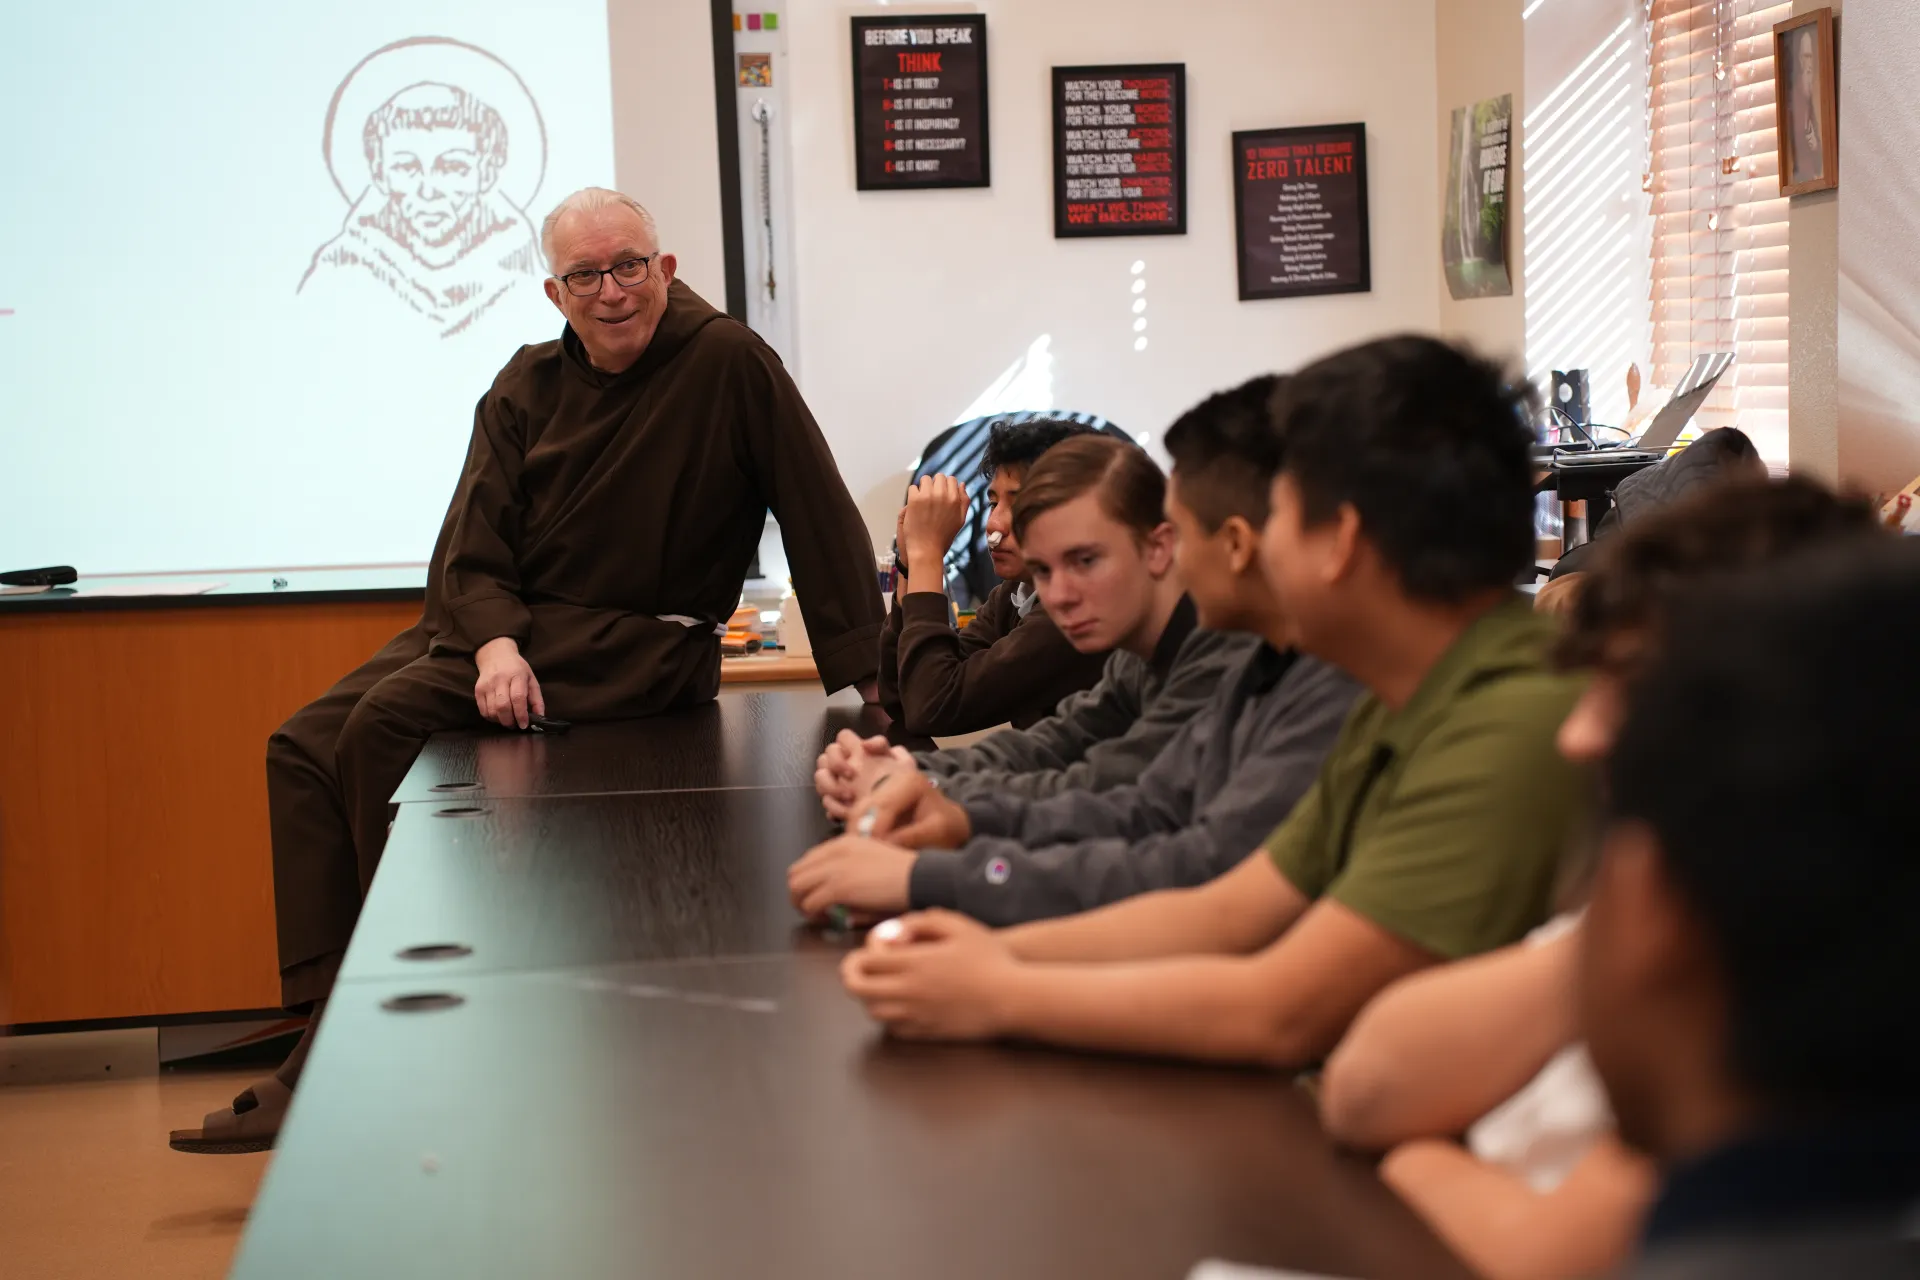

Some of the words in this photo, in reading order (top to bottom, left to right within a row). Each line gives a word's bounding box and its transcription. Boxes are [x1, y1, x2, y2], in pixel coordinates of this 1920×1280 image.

[865, 29, 908, 45] BEFORE
[909, 28, 934, 45] YOU
[935, 27, 972, 44] SPEAK
[897, 52, 943, 72] THINK
[1065, 80, 1098, 90] WATCH
[1098, 80, 1122, 90] YOUR
[1065, 90, 1083, 101] FOR
[1083, 90, 1104, 101] THEY
[1104, 89, 1139, 100] BECOME
[1065, 105, 1101, 115] WATCH
[1103, 104, 1131, 115] YOUR
[1065, 115, 1083, 126] FOR
[1083, 114, 1103, 125] THEY
[1103, 113, 1136, 125] BECOME
[1065, 129, 1101, 139] WATCH
[1101, 128, 1128, 139] YOUR
[1065, 139, 1084, 151] FOR
[1084, 139, 1105, 150] THEY
[1105, 138, 1140, 150] BECOME
[1066, 154, 1103, 164] WATCH
[1103, 153, 1133, 164] YOUR
[1247, 160, 1289, 180] ZERO
[1293, 155, 1353, 176] TALENT
[1066, 178, 1097, 188] WATCH
[1097, 178, 1121, 188] YOUR
[1067, 202, 1104, 214] WHAT
[1107, 202, 1127, 213] WE
[1067, 212, 1094, 224] WE
